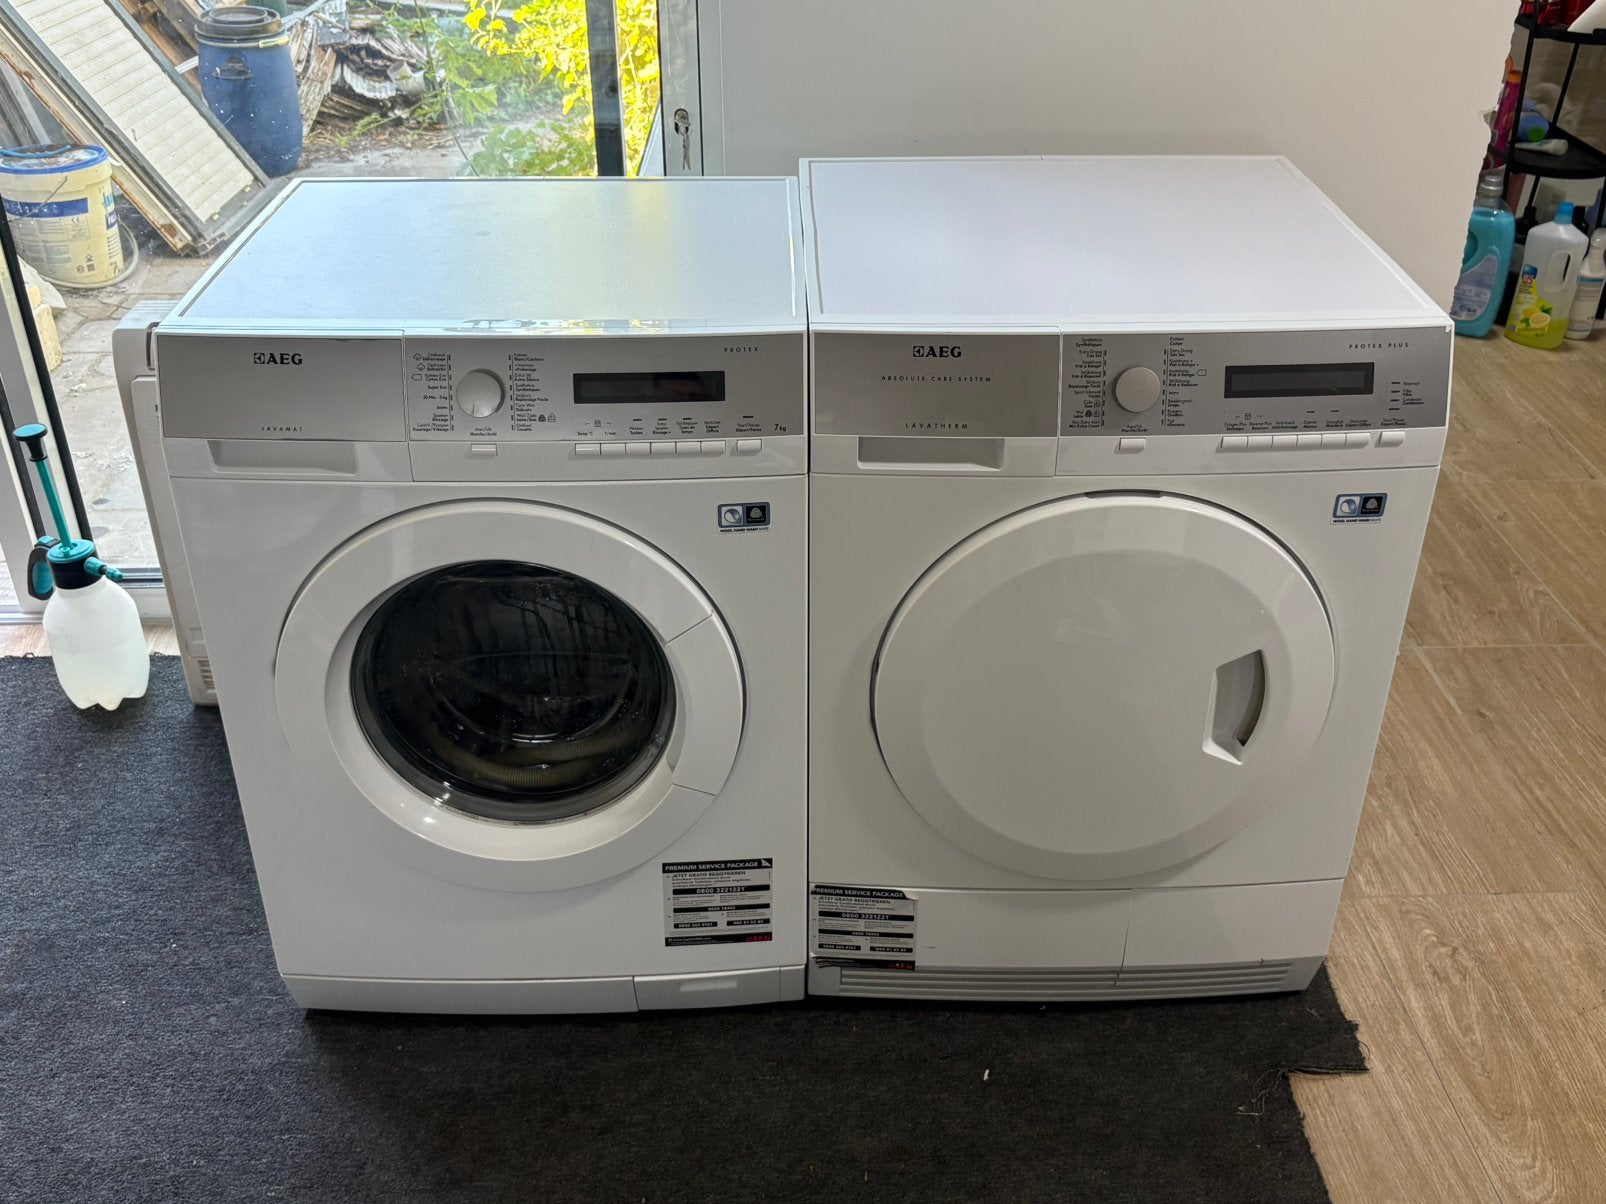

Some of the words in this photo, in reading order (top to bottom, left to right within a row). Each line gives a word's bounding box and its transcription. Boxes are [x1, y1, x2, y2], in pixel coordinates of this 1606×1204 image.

[925, 346, 961, 358] AEG
[266, 353, 303, 365] AEG
[727, 861, 759, 869] PACKAGE
